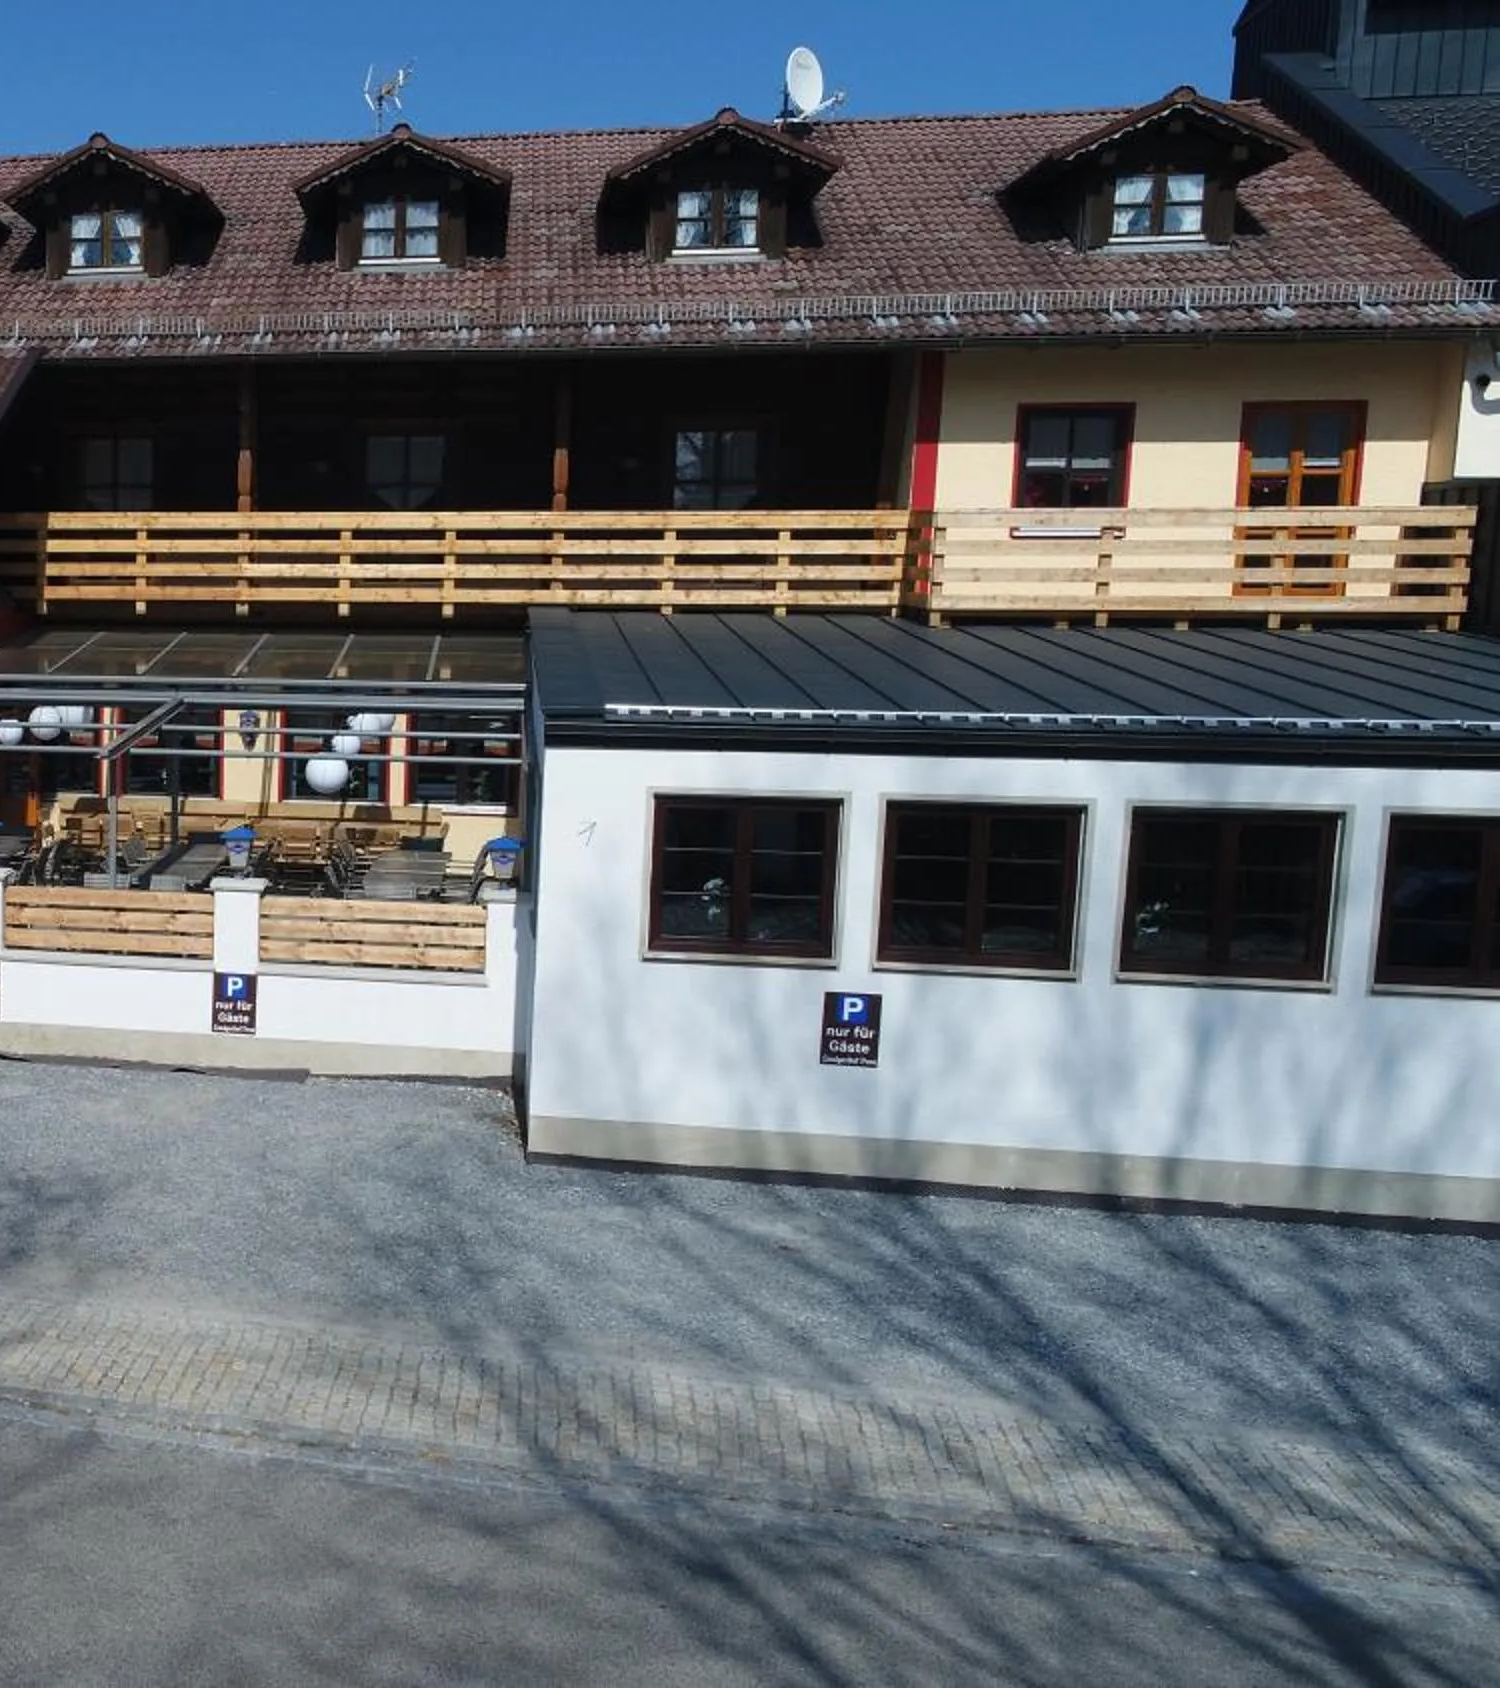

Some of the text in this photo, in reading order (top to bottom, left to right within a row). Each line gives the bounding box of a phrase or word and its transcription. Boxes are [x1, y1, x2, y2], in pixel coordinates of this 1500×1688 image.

[227, 976, 243, 997] P
[842, 996, 864, 1021] P
[826, 1025, 876, 1039] nur für
[829, 1039, 871, 1054] Gäste
